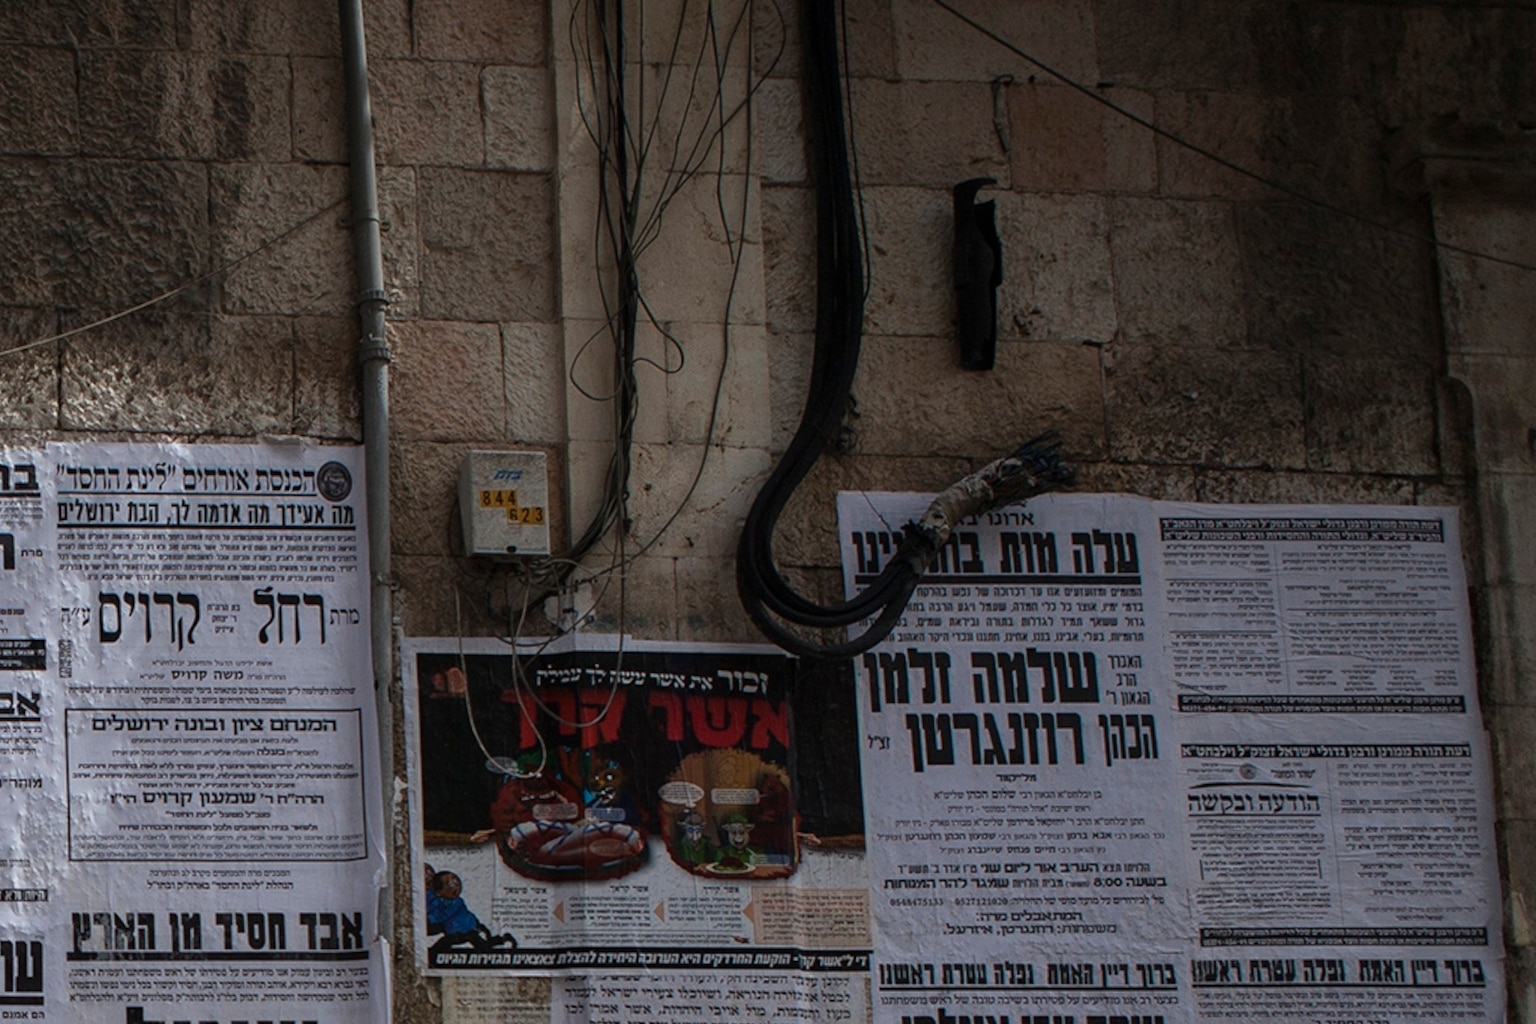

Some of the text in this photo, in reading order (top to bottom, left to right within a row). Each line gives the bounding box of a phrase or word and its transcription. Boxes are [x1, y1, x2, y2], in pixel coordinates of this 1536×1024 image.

[183, 468, 249, 491] אורחים
[255, 468, 316, 491] הכנסת
[483, 490, 516, 506] 844
[58, 499, 121, 522] ירושלים
[127, 503, 159, 523] הבת
[248, 504, 270, 524] מה
[277, 504, 325, 527] אעידך
[332, 505, 354, 525] מה
[509, 507, 543, 523] 623
[999, 528, 1141, 573] עלה מות
[98, 590, 201, 652] קרויס
[253, 585, 326, 645] רחל
[330, 607, 360, 625] מרת
[170, 669, 244, 682] משה קרויס
[585, 664, 607, 687] לך
[649, 673, 685, 688] אשר
[688, 674, 713, 690] את
[717, 669, 768, 695] זכור
[864, 647, 1100, 713] שלמה זלמן
[1116, 673, 1137, 687] הרב
[91, 715, 337, 735] המנחם ציון ובונה ירושלים
[648, 692, 790, 749] אשר
[905, 712, 1085, 773] רוזנגרטן
[1098, 713, 1159, 767] הכהן
[143, 791, 192, 808] קרויס
[199, 791, 256, 808] שמעון
[1186, 793, 1320, 814] הודעה ובקשה
[71, 911, 363, 954] אבד חסיד מן הארץ
[681, 953, 702, 964] היא
[879, 960, 1177, 987] ברוך דיין האמת נפלה עטרת ראשנו
[1248, 959, 1296, 985] עטרת
[1302, 958, 1346, 985] נפלה
[1358, 959, 1406, 985] האמת
[1410, 959, 1439, 986] דיין
[1443, 959, 1485, 986] ברוך
